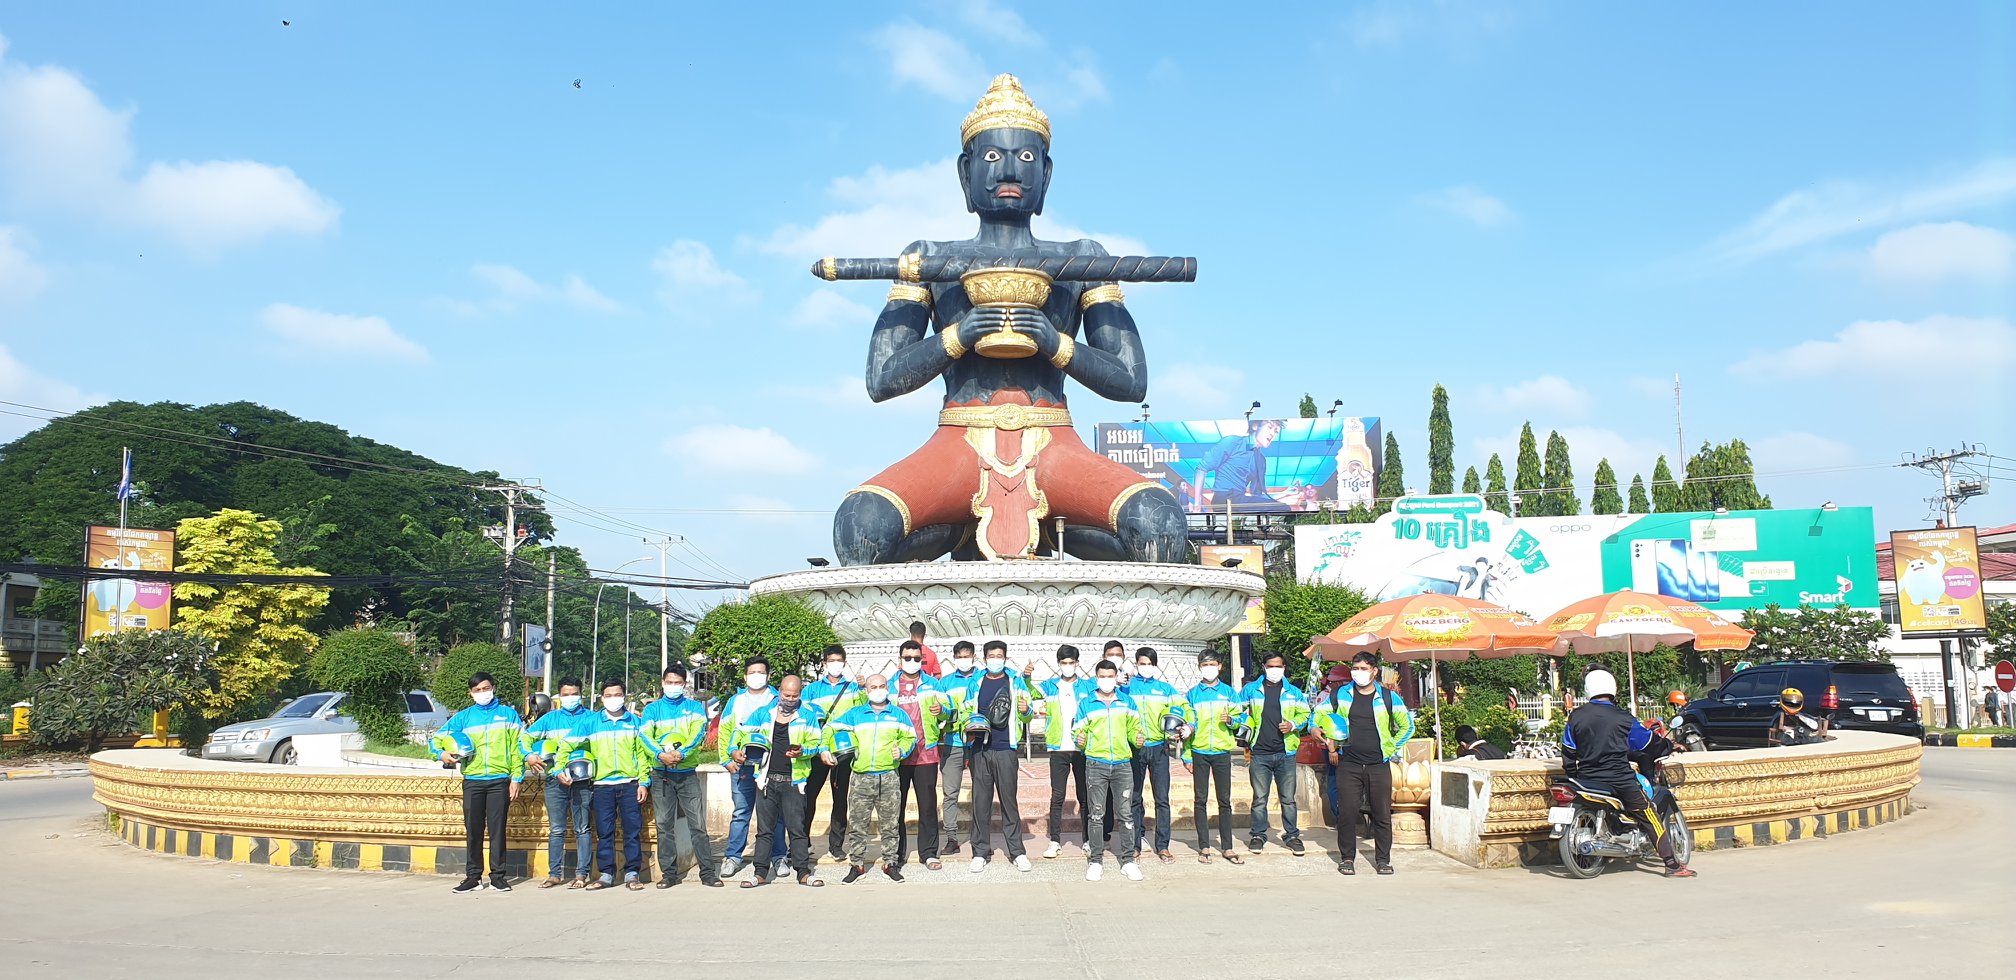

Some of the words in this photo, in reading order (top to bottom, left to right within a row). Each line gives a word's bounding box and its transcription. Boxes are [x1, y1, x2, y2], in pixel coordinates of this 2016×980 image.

[1106, 430, 1143, 444] អបអរ
[1342, 478, 1370, 492] Tiger
[1392, 518, 1420, 540] 10
[1426, 510, 1490, 549] គ្រឿង
[1799, 591, 1845, 603] Smart
[1405, 617, 1470, 626] GANZBERG
[1953, 618, 1967, 626] 4G
